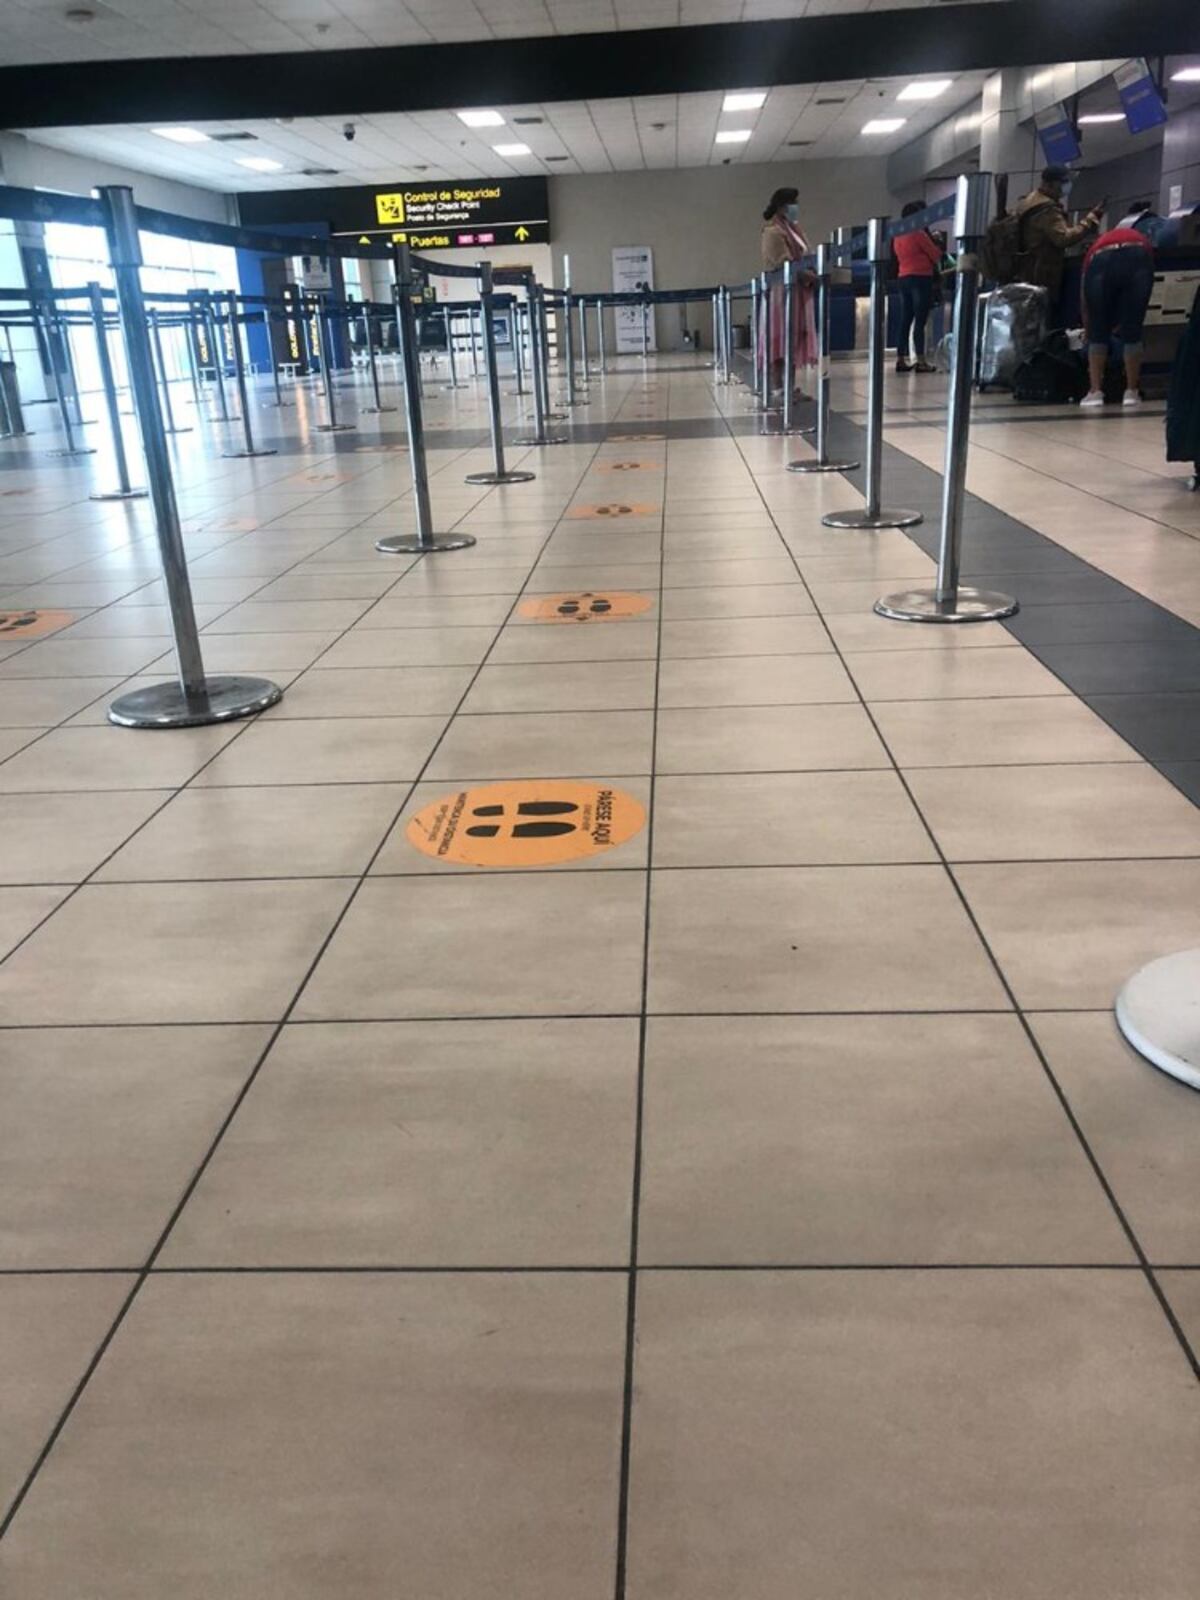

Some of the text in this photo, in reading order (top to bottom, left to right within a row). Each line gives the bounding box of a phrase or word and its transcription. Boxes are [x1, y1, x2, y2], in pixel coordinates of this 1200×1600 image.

[404, 188, 501, 202] Control de Seguridad
[406, 203, 435, 213] Security
[410, 236, 450, 247] Puertas
